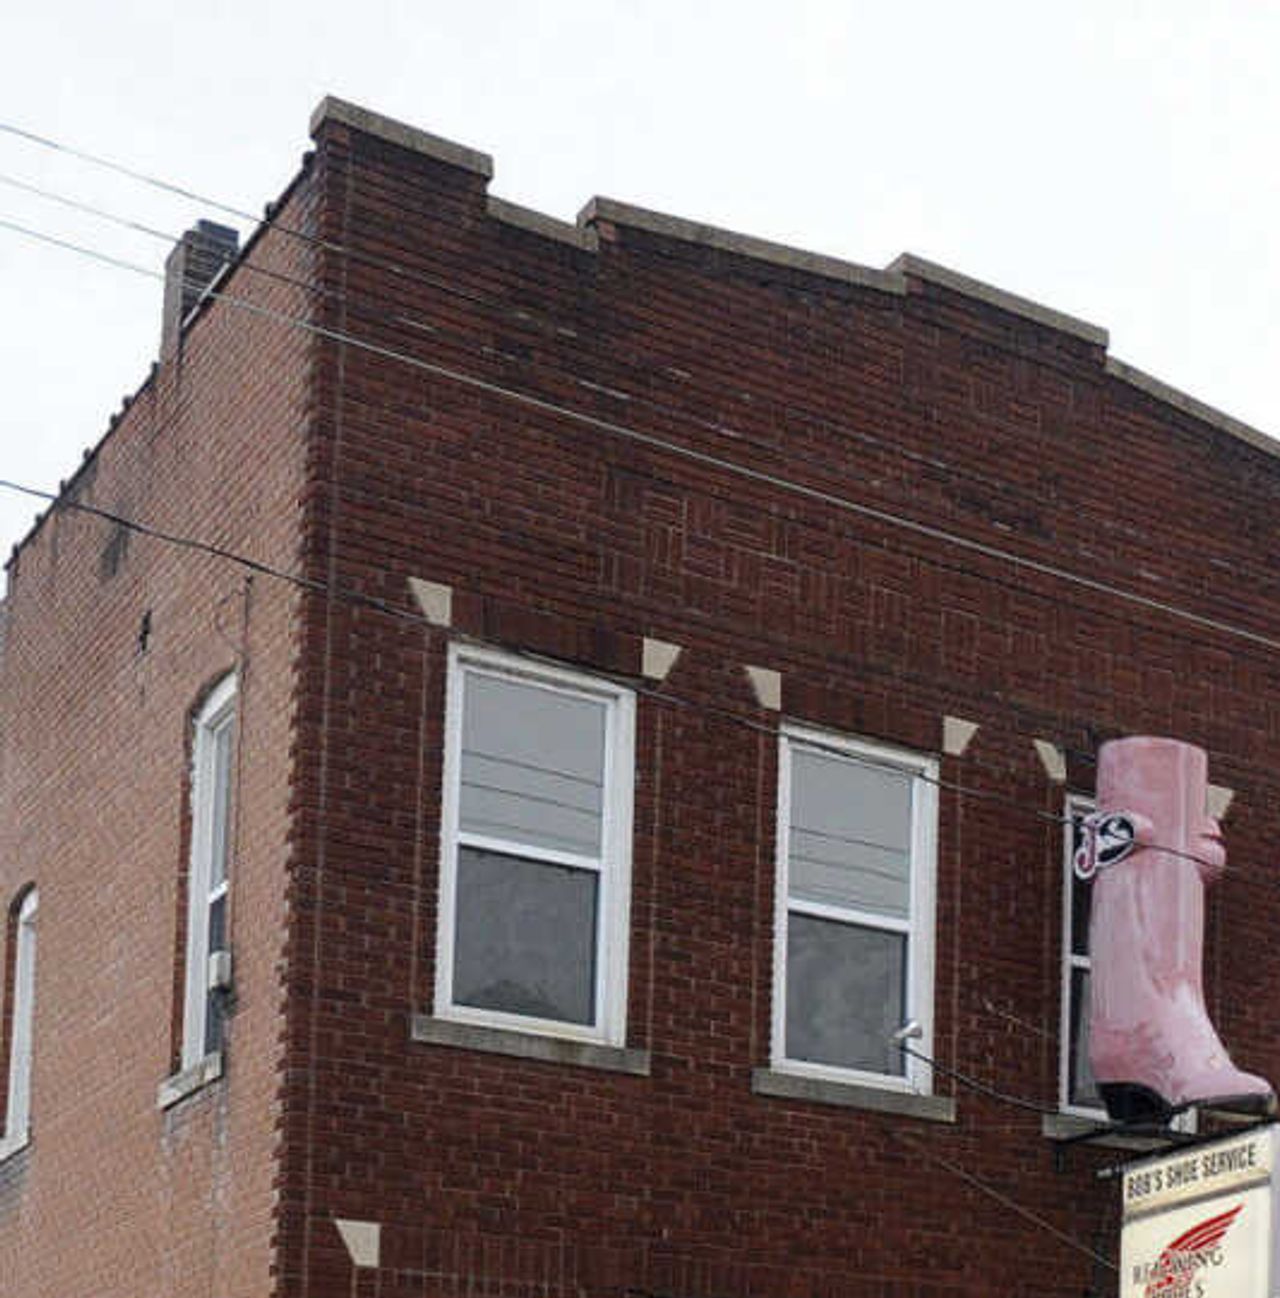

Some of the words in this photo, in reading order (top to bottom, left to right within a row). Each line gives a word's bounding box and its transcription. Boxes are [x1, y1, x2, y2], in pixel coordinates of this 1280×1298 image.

[1127, 1168, 1164, 1199] BOB'S
[1166, 1158, 1199, 1189] SHOE
[1201, 1143, 1257, 1178] SERVICE
